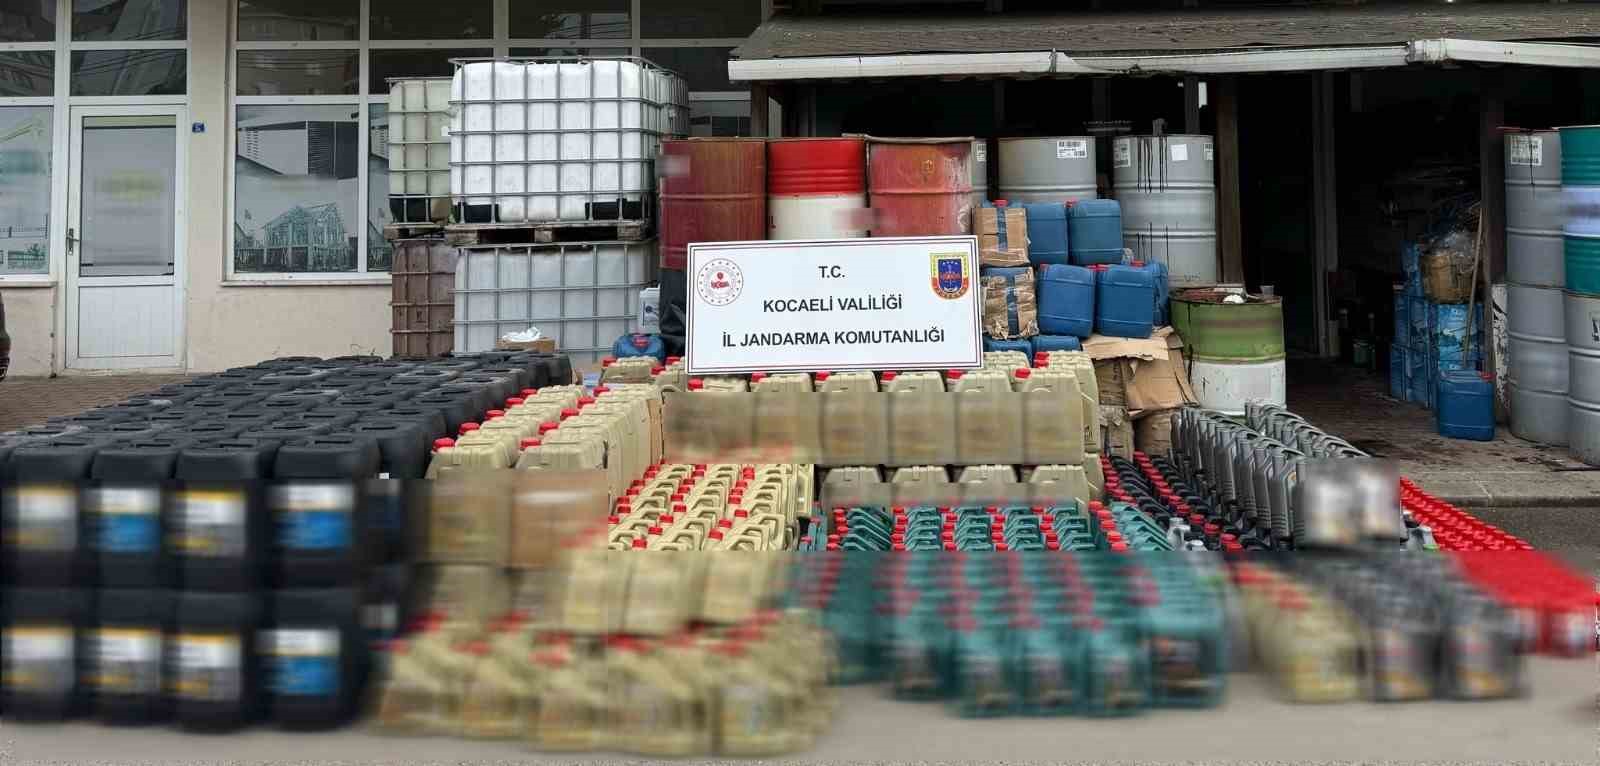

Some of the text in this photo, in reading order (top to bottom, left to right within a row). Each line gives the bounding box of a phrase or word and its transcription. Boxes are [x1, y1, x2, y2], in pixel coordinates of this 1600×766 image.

[818, 265, 846, 279] T.C.
[763, 293, 902, 313] KOCAELİ VALİLİĞİ
[722, 326, 945, 348] İL JANDARMA KOMUTANLIĞI
